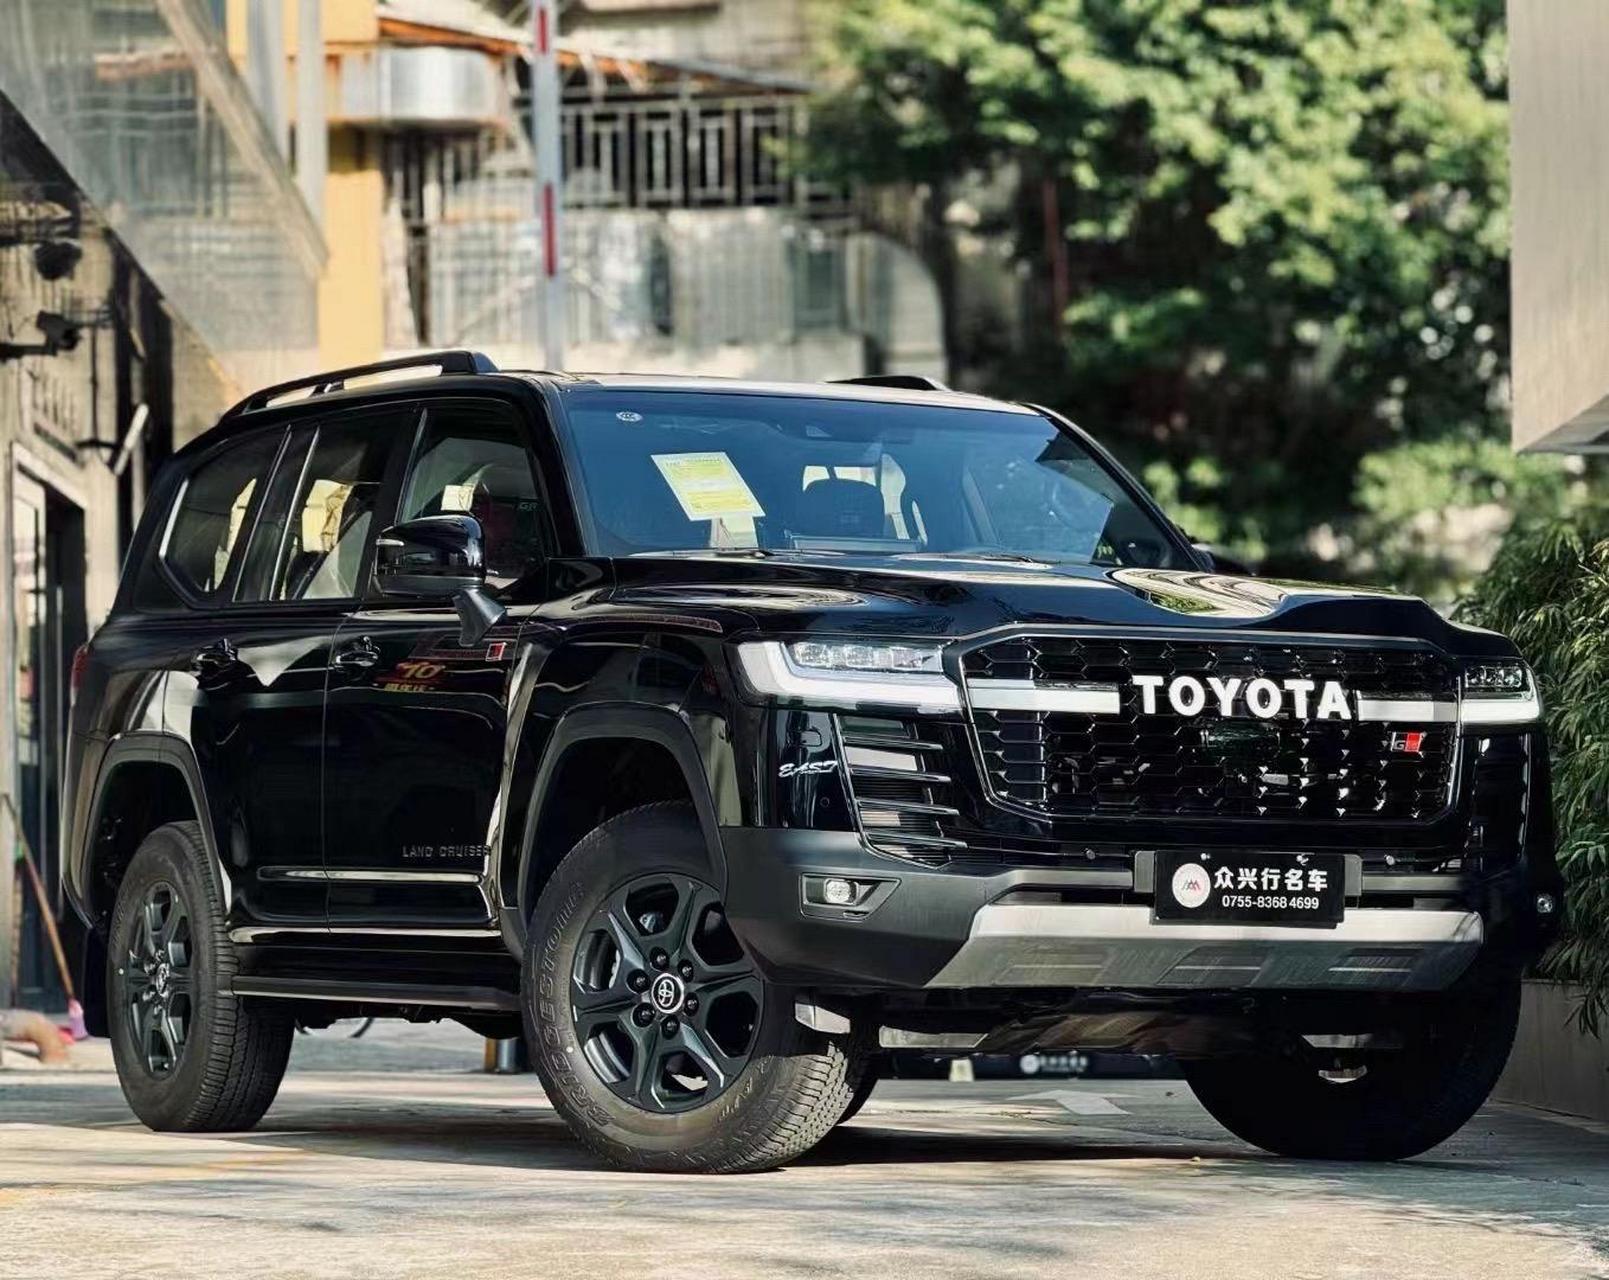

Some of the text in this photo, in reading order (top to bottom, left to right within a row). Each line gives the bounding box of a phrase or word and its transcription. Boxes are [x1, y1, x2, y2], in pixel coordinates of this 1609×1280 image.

[1132, 675, 1351, 720] TOYOTA
[402, 845, 491, 858] LAND CRUISER
[1214, 866, 1328, 892] 众兴行名车
